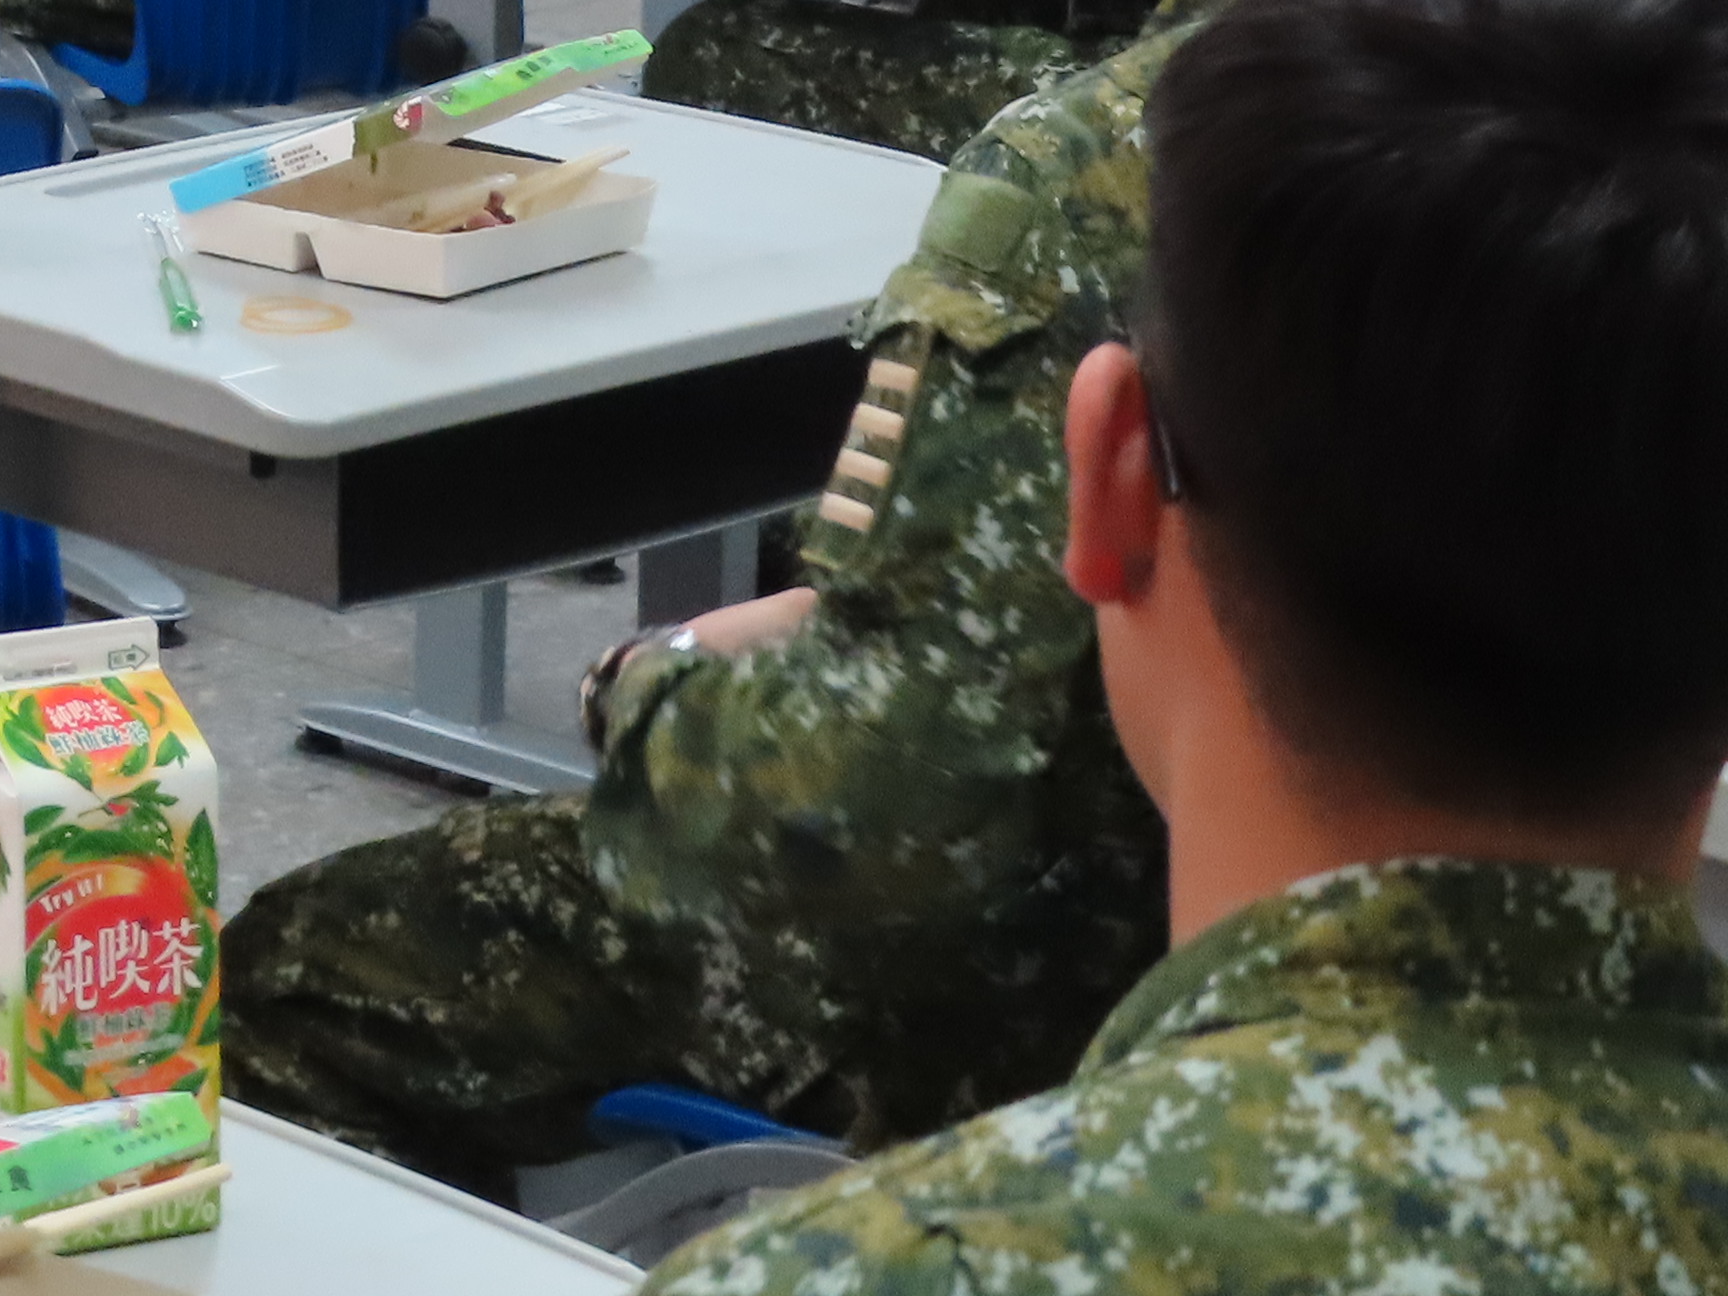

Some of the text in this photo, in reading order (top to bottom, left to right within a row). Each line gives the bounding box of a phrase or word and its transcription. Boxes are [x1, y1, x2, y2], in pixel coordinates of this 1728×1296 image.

[44, 697, 123, 730] 純喫茶
[39, 883, 78, 913] Try
[40, 916, 205, 1017] 純喫茶
